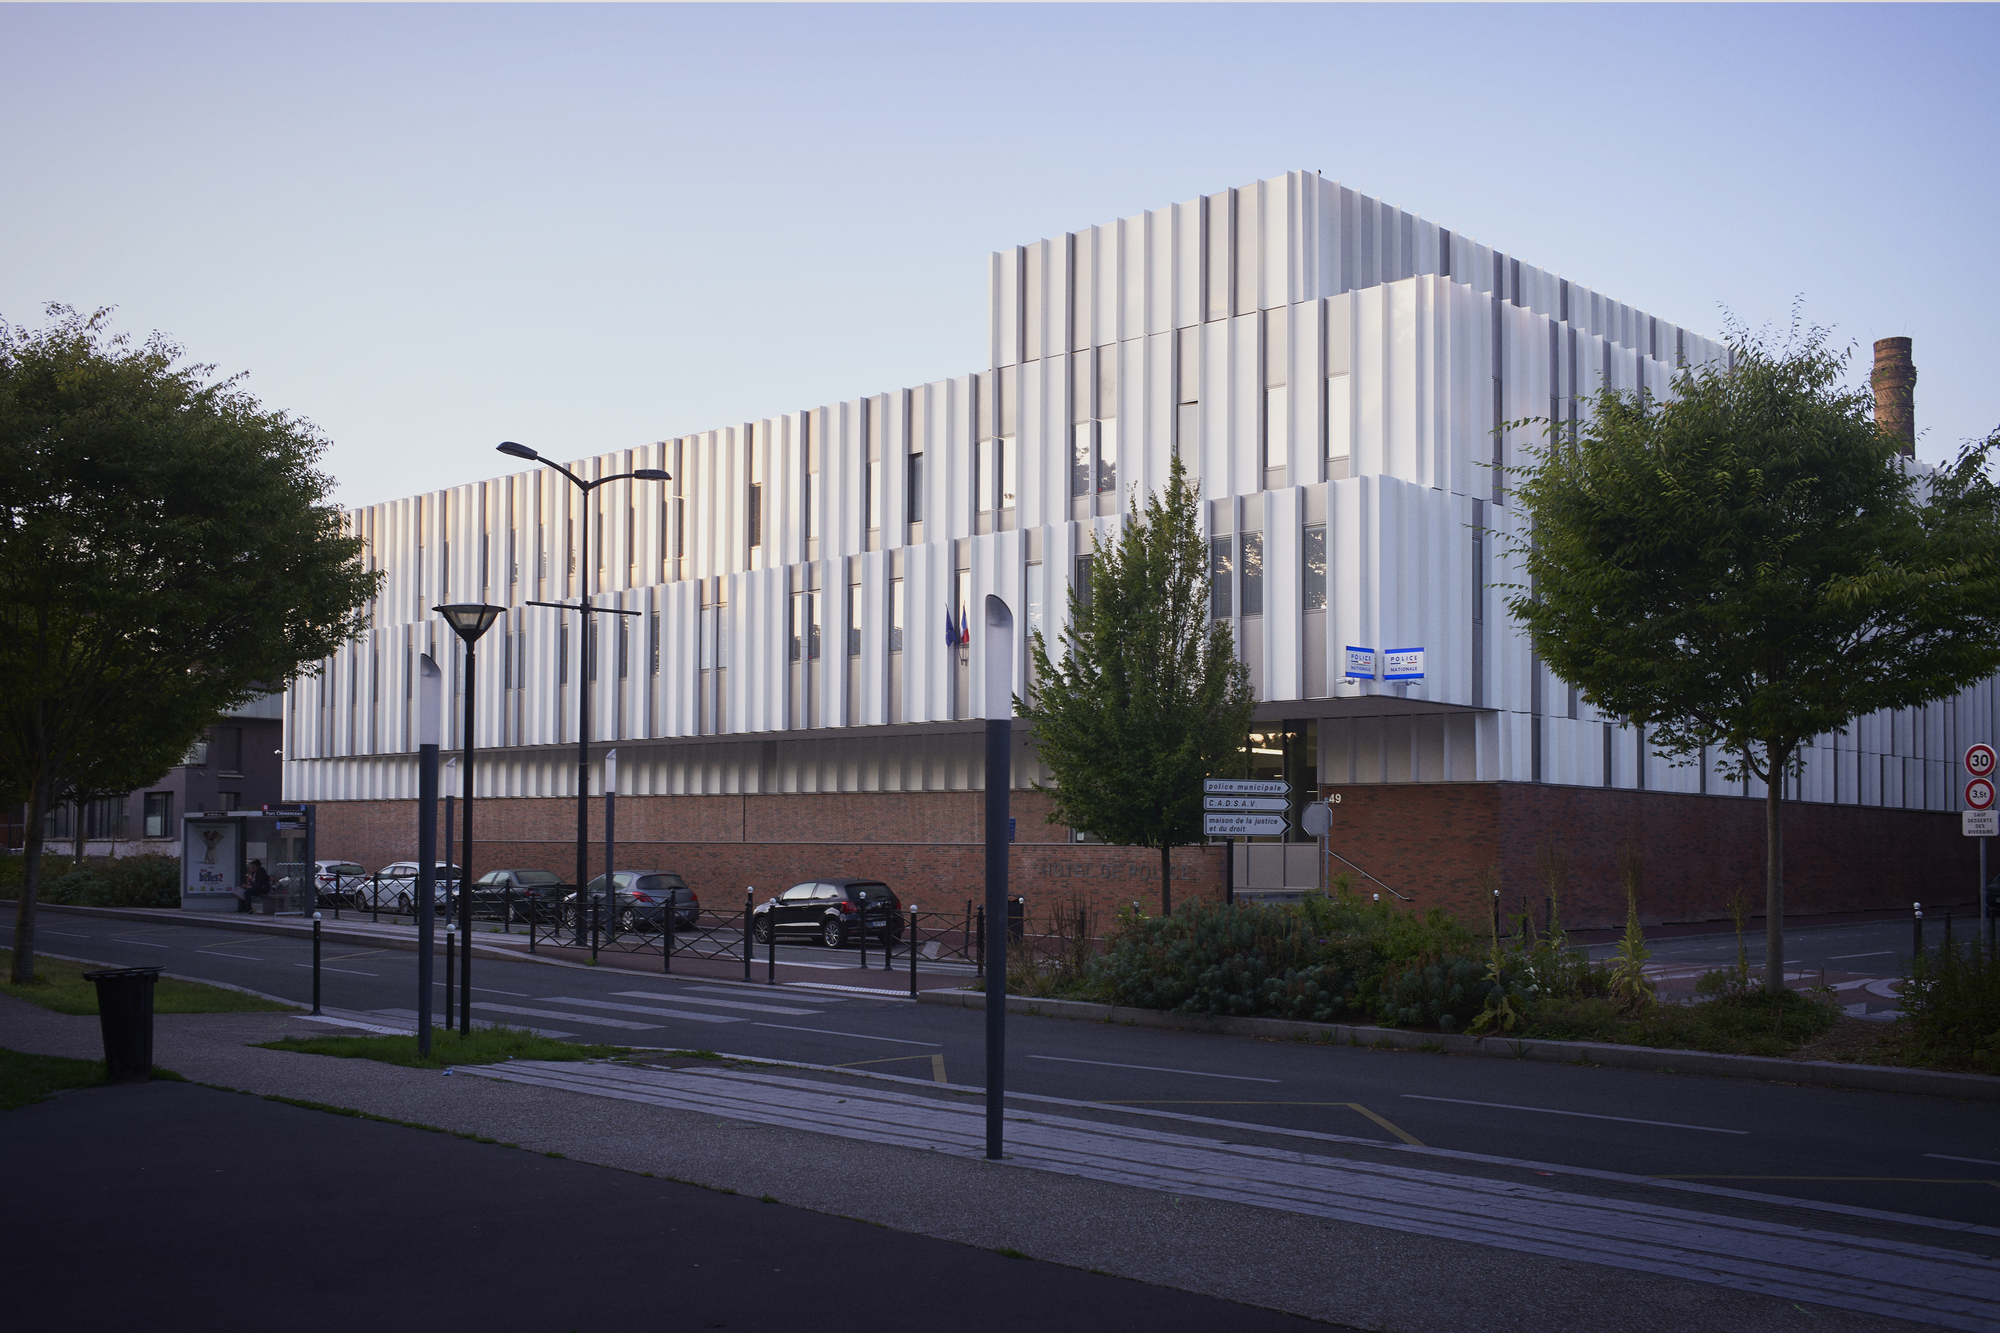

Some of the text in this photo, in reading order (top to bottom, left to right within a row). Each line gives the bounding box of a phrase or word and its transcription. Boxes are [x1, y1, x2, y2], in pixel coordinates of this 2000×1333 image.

[1972, 755, 1988, 766] 30
[1208, 783, 1282, 792] police municipale
[1208, 799, 1258, 807] C.A.D.S.A.V.
[1328, 793, 1342, 804] 49
[1254, 817, 1279, 826] justice
[1100, 863, 1121, 879] DE
[1128, 864, 1191, 880] POLCE
